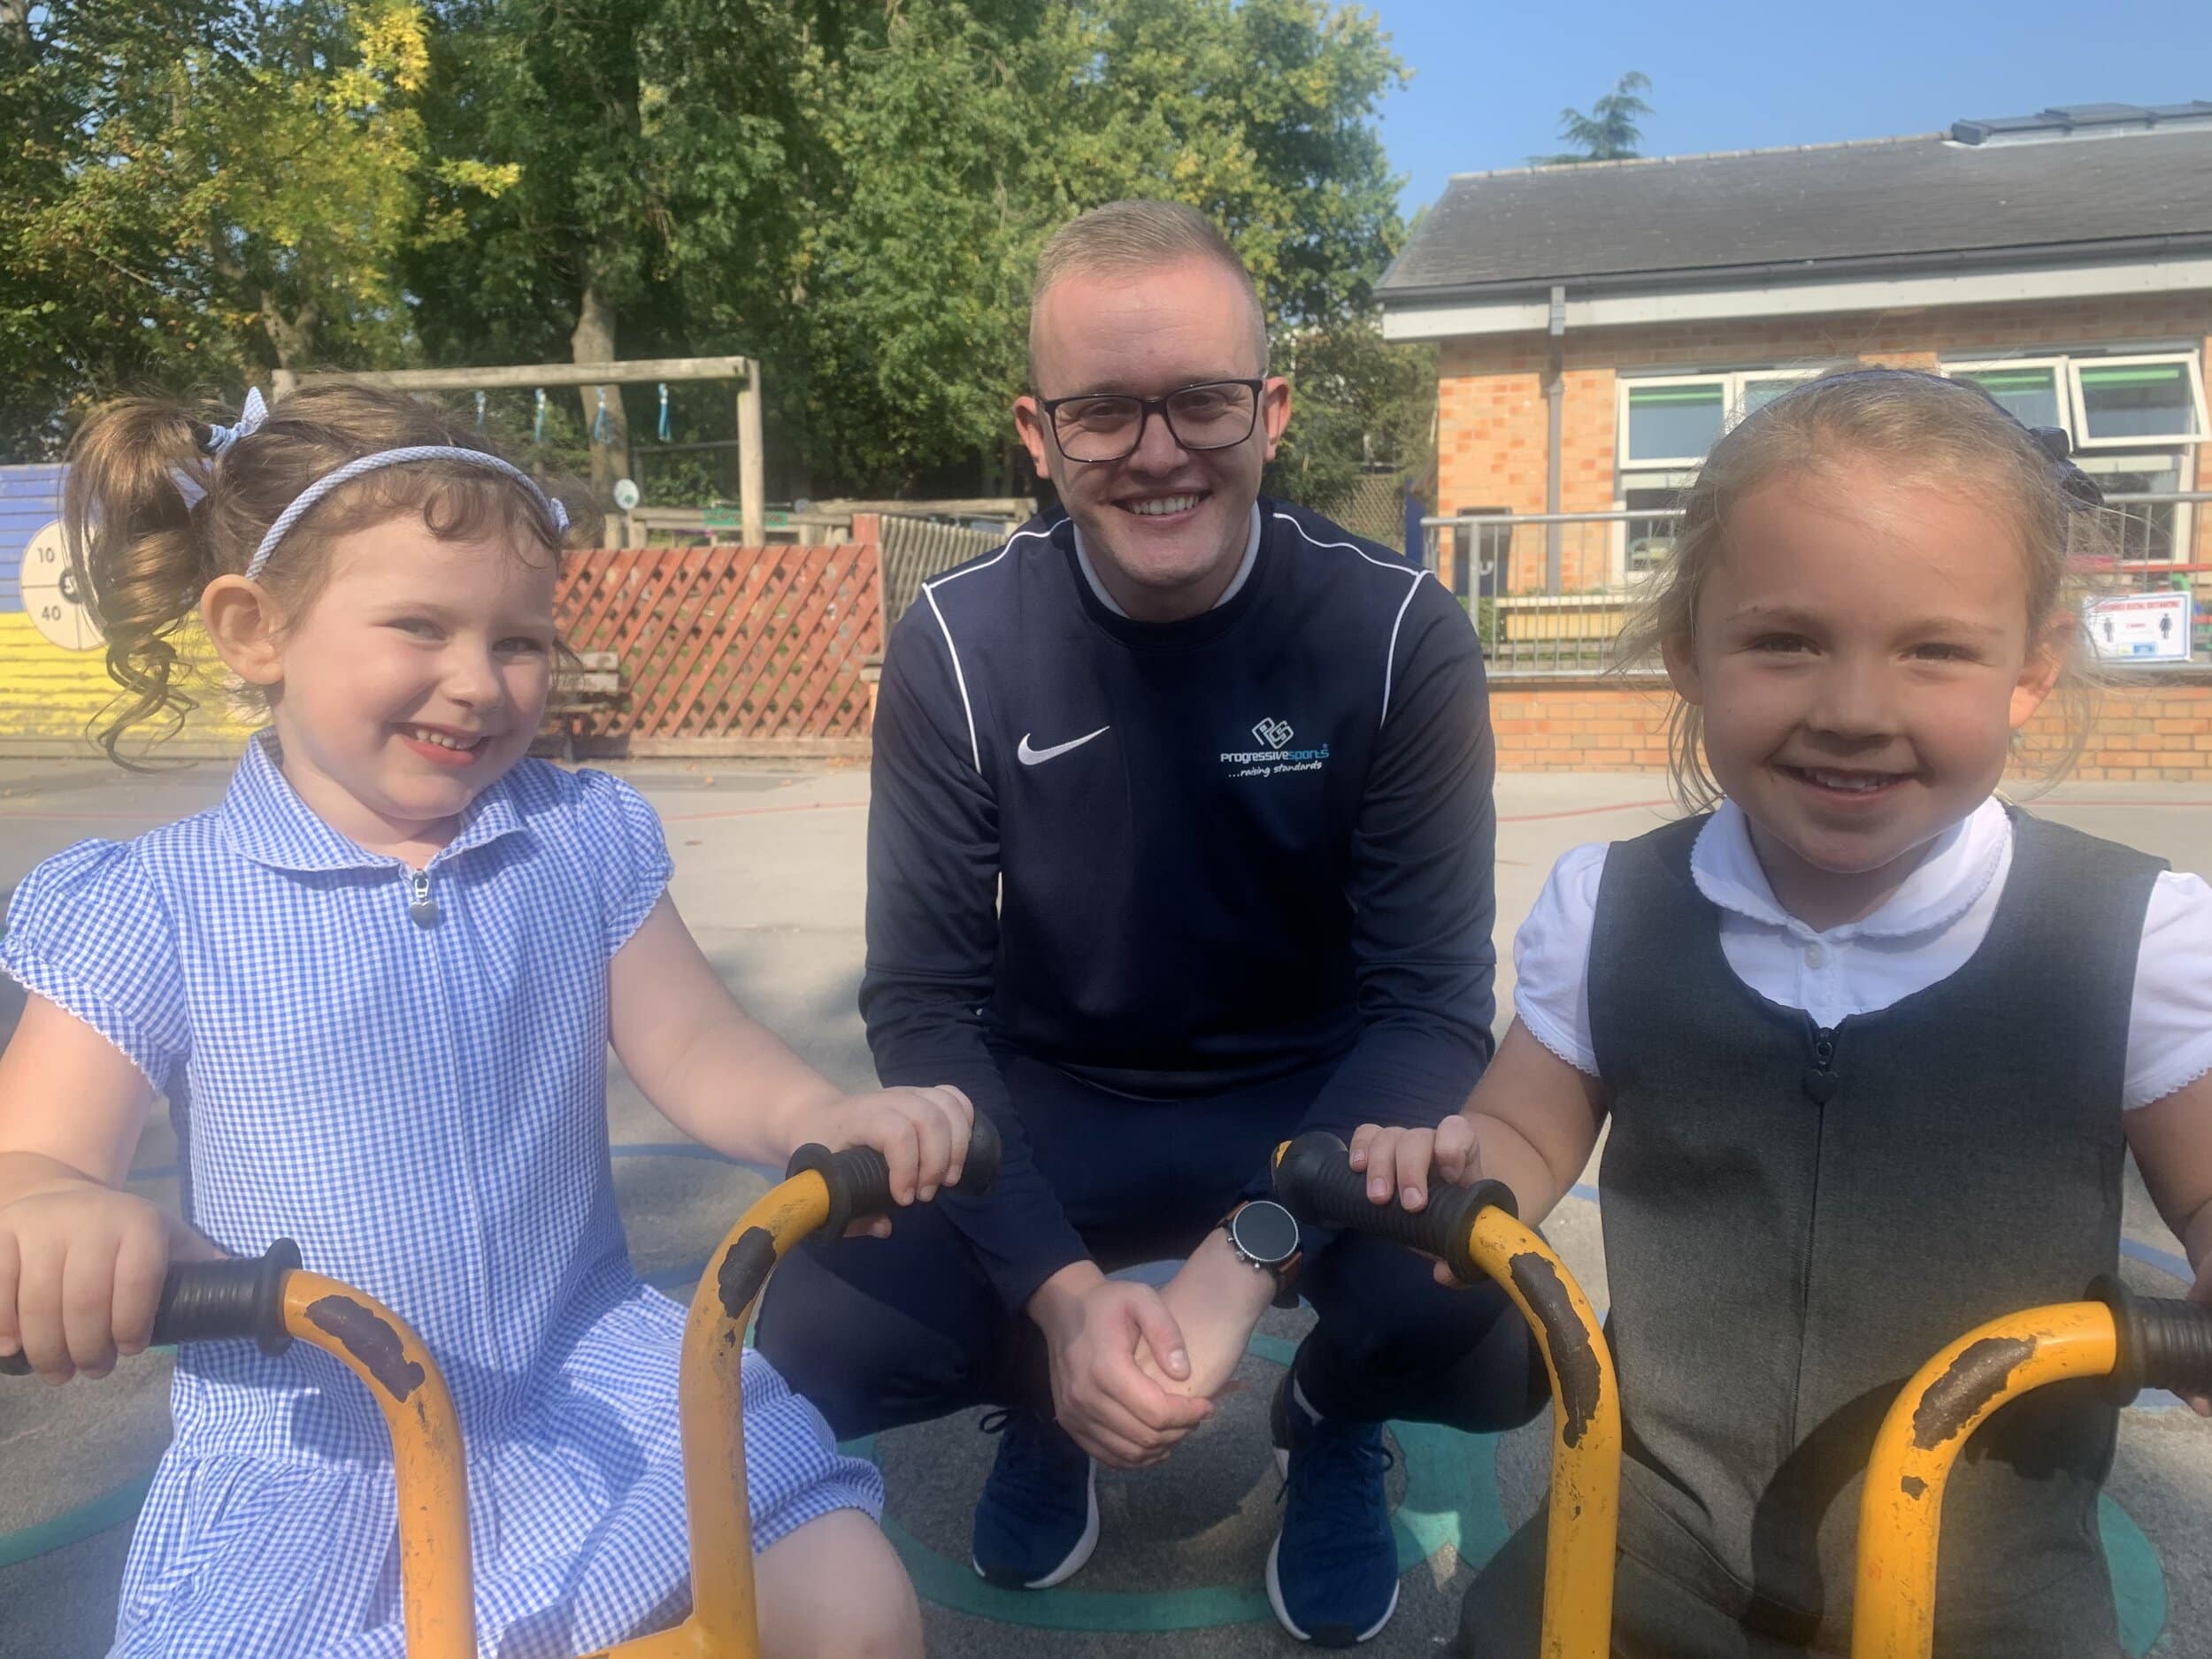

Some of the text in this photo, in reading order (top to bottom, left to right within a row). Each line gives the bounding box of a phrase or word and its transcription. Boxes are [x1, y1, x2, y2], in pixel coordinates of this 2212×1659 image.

[37, 547, 55, 564] 10
[42, 605, 61, 621] 40
[1273, 760, 1322, 772] standards
